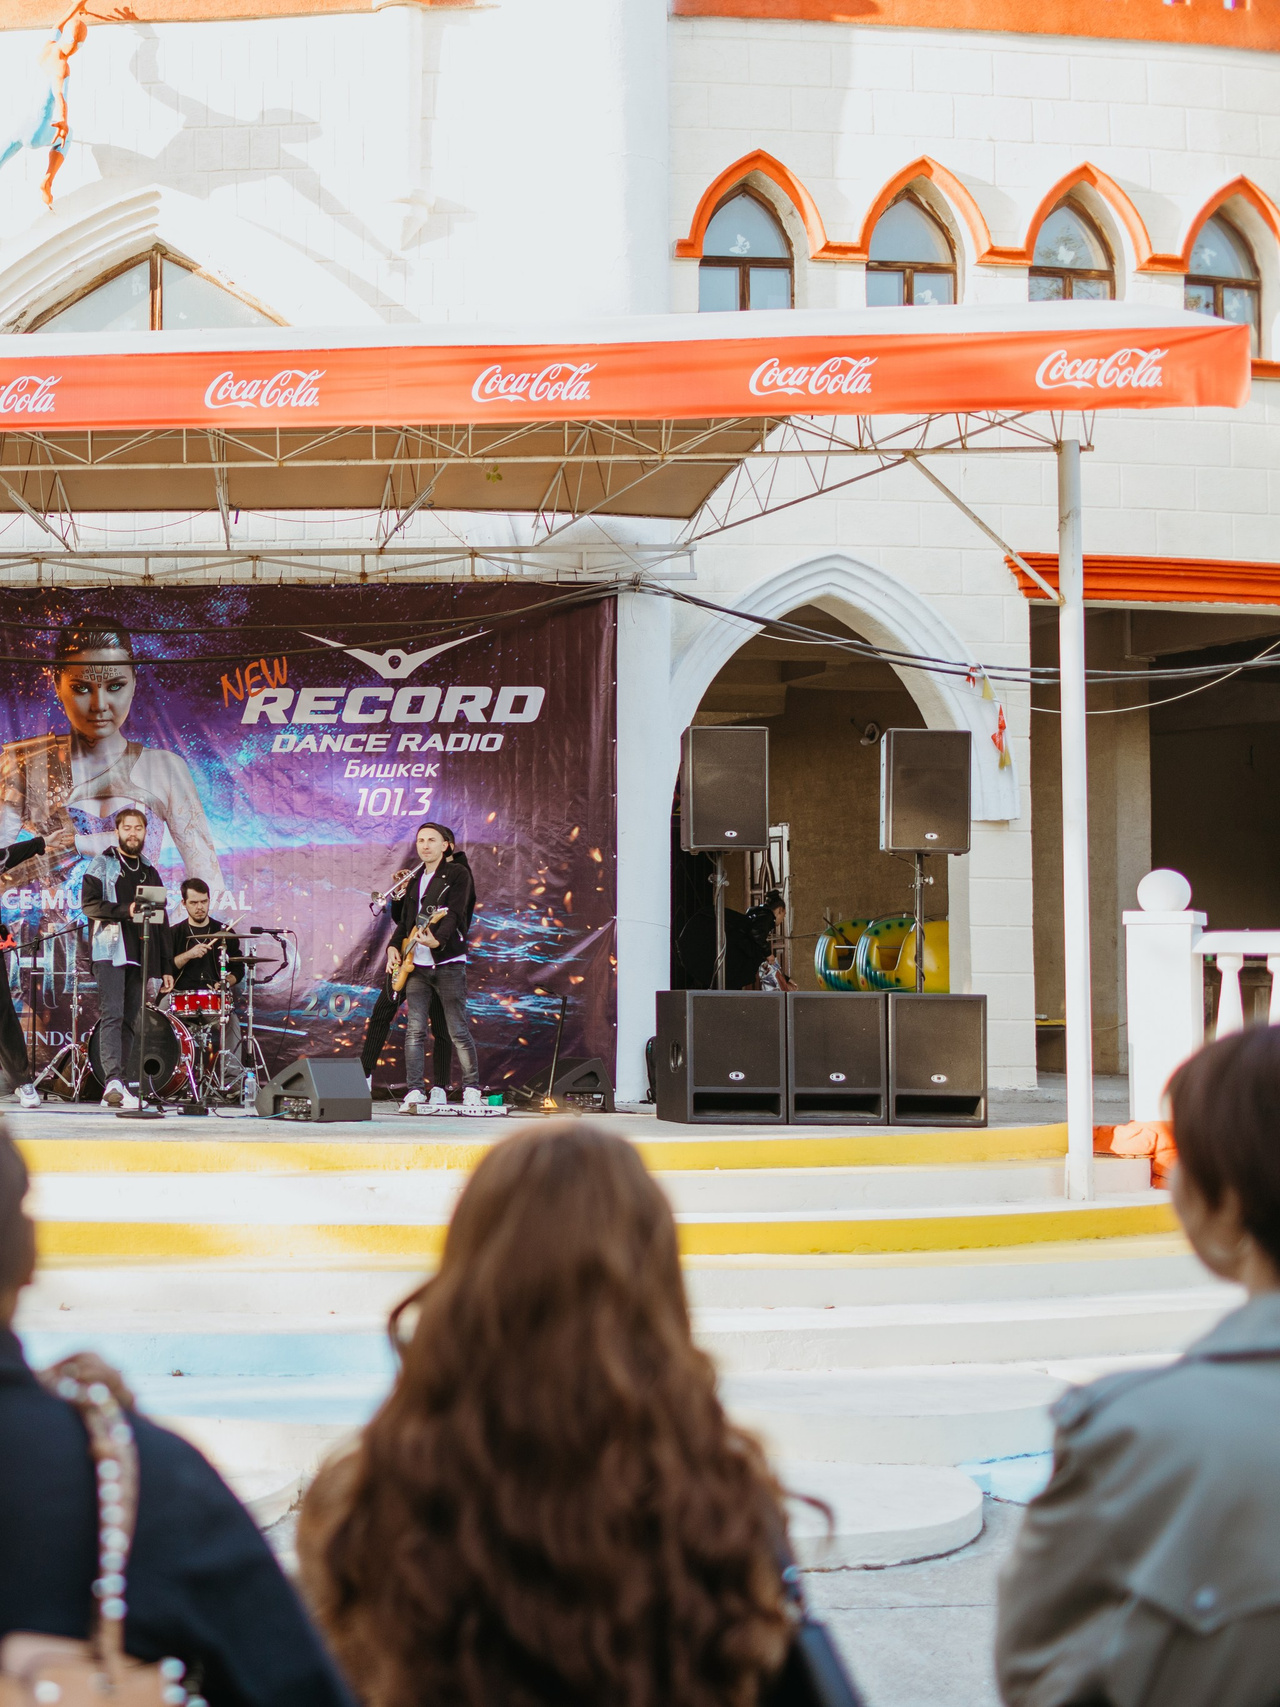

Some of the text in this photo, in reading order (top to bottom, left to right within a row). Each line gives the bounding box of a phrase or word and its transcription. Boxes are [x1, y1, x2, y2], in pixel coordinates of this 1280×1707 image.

[471, 362, 598, 402] Coca-Cola
[749, 356, 878, 396] Coca-Cola
[1035, 348, 1169, 390] Coca-Cola
[204, 369, 327, 409] Coca-Cola
[220, 656, 288, 708] NEW
[241, 686, 546, 724] RECORD
[271, 733, 504, 752] DANCE RADIO
[344, 759, 440, 779] Бишкек
[357, 787, 434, 816] 101.3
[301, 992, 352, 1017] 2.0
